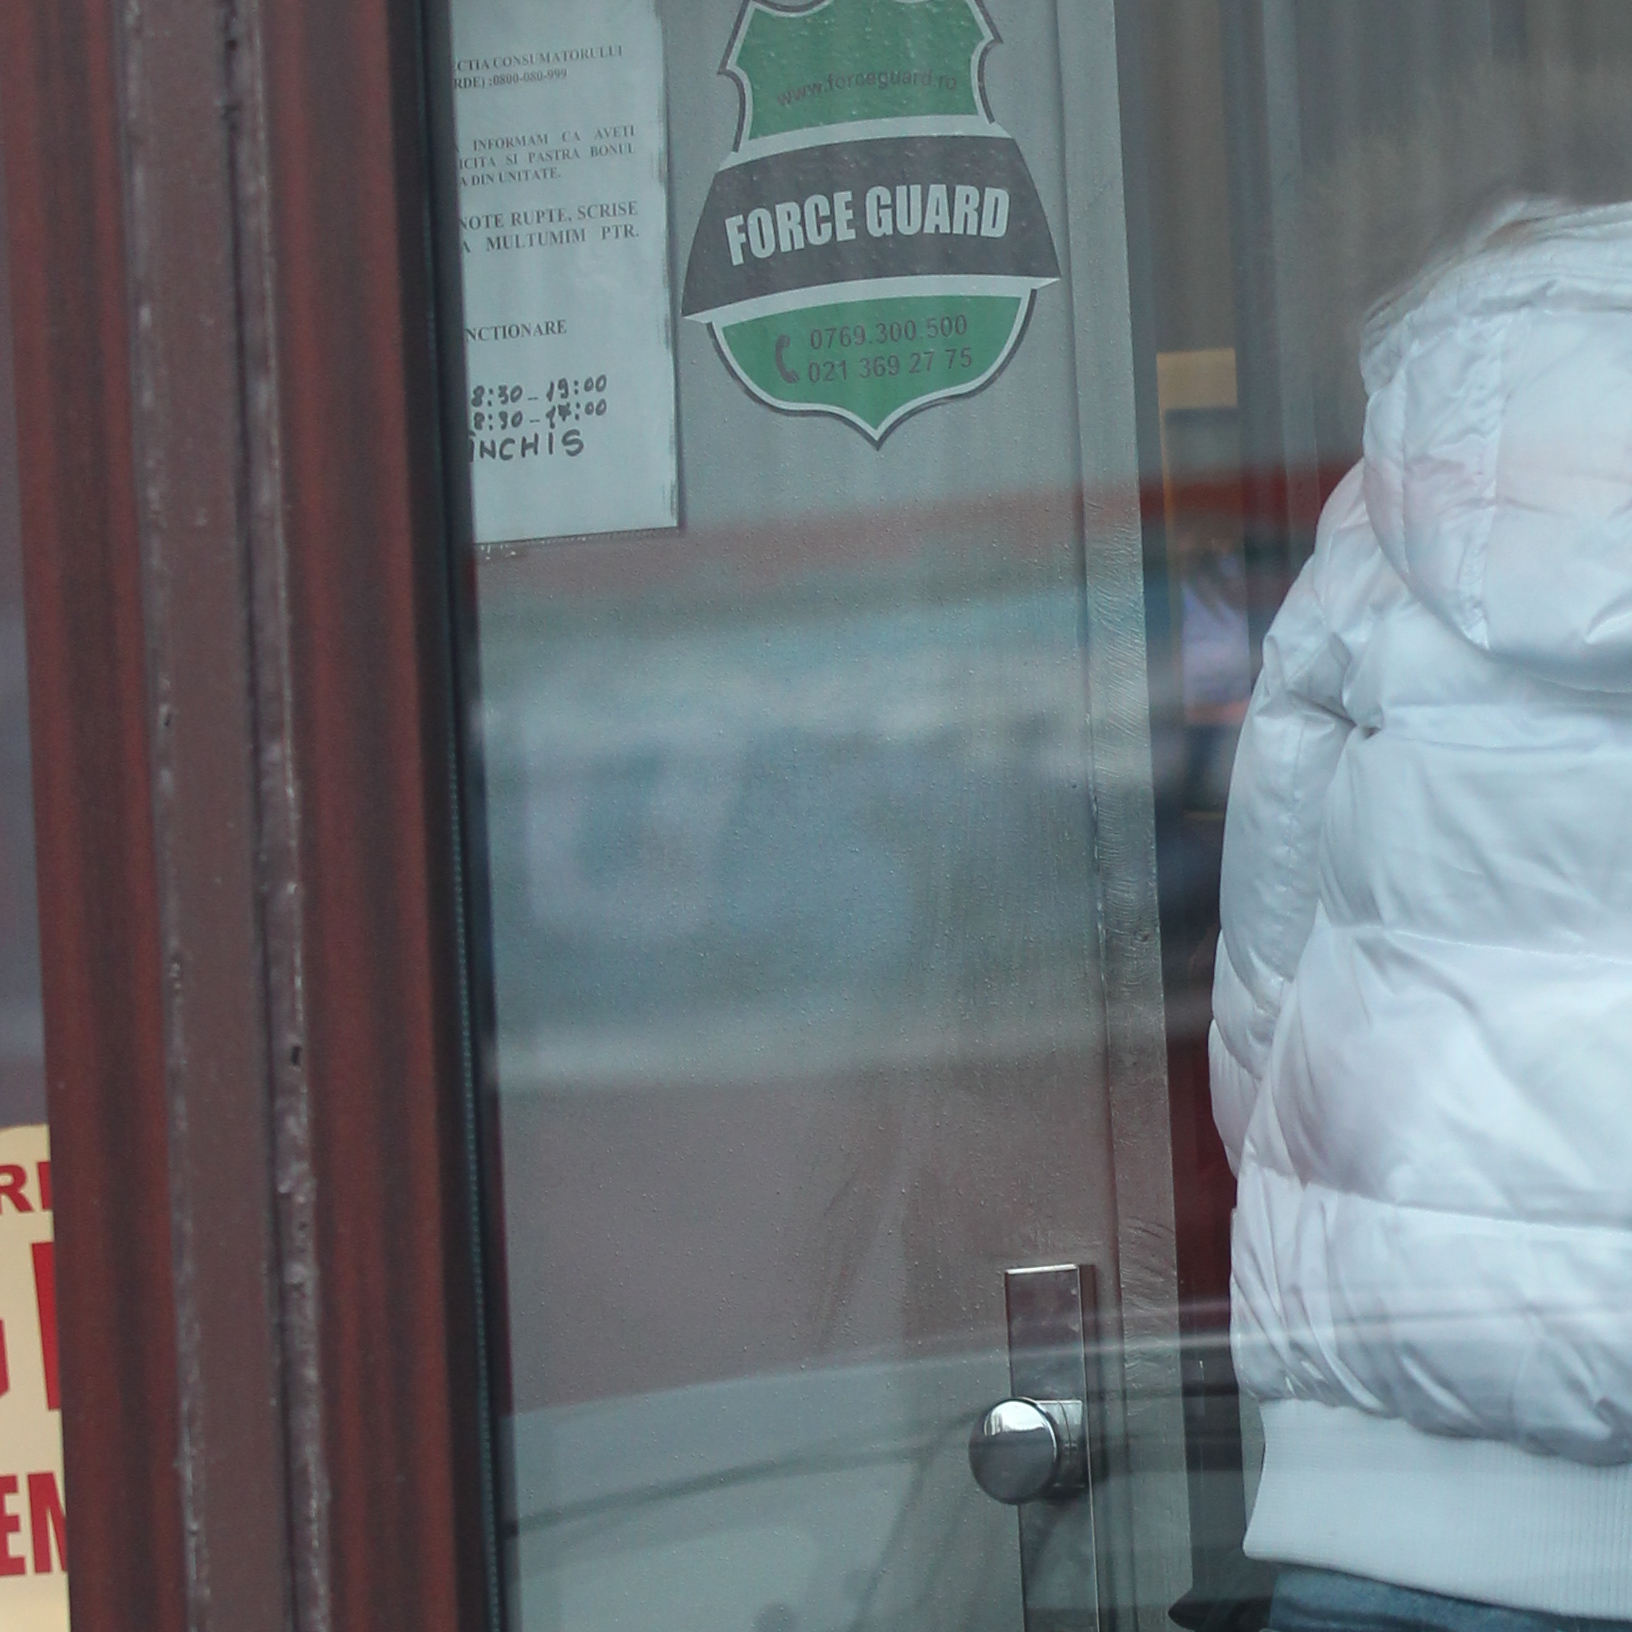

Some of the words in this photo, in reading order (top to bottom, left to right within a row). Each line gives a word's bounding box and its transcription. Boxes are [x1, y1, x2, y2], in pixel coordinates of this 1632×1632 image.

[493, 45, 623, 69] CONSUMATORULUI
[777, 69, 957, 106] www.forceguard.ro
[473, 133, 549, 152] INFORMAM
[561, 131, 581, 143] CA
[594, 125, 636, 140] AVETI
[506, 154, 518, 166] SI
[528, 147, 580, 164] PASTRA
[590, 143, 636, 158] BONUL
[472, 174, 495, 186] DIN
[499, 167, 561, 184] UNITATE.
[577, 201, 638, 220] SCRISE
[487, 228, 586, 252] MULTUMIM
[601, 223, 640, 241] PTR.
[725, 190, 856, 266] FORCE
[865, 184, 1010, 239] GUARD
[810, 314, 967, 350] 0769.300.500
[808, 360, 847, 383] 021
[859, 355, 900, 379] 369
[908, 351, 935, 374] 27
[945, 347, 972, 369] 75
